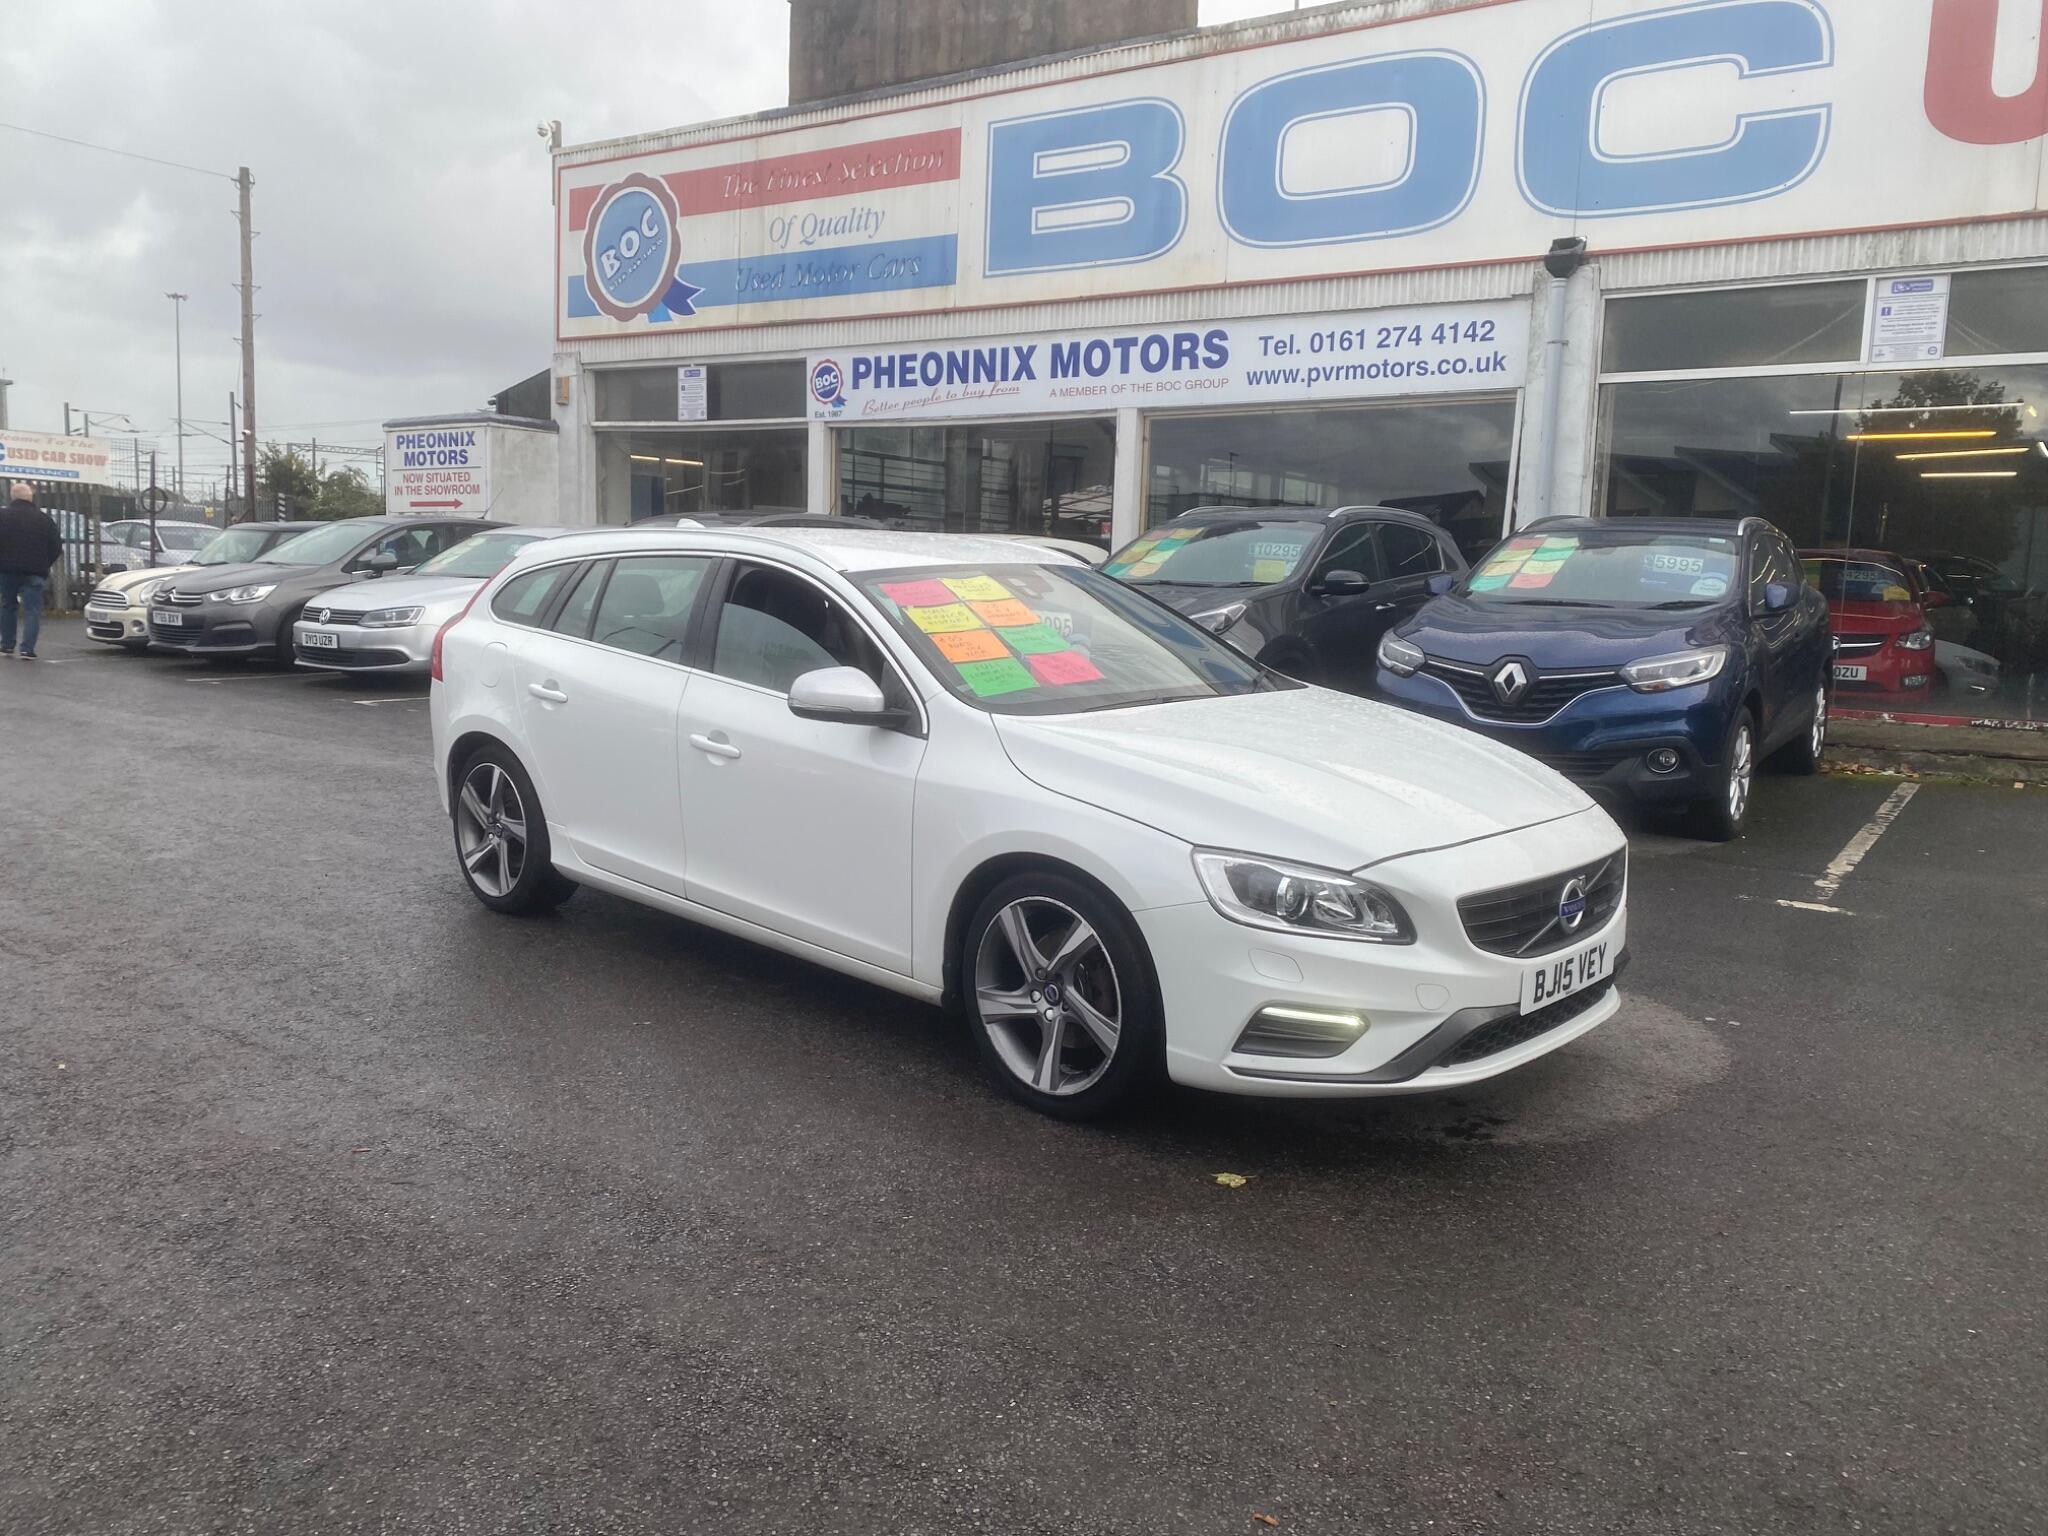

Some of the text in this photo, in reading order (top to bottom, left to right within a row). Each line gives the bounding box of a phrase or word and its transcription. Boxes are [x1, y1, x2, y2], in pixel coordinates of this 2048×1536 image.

[984, 0, 1834, 277] BOC
[722, 148, 944, 198] The Finest Selection
[769, 206, 885, 248] Of Quality
[601, 207, 659, 279] BOC
[735, 253, 924, 293] Used Motor Cars
[1258, 319, 1496, 357] Tel. 0161 274 4142
[852, 329, 1229, 390] PHEONNIX MOTORS
[1246, 351, 1507, 387] www.pvrmotors.co.uk
[816, 371, 838, 389] BOC
[1050, 378, 1229, 398] A MEMBER OF THE BOC GROUP
[862, 380, 1020, 416] Better people to buy from
[396, 431, 476, 449] PHEONNIX
[7, 447, 39, 461] USED
[41, 450, 66, 463] CAR
[69, 453, 108, 466] SHOW
[404, 449, 468, 467] MOTORS
[394, 484, 480, 496] IN THE SHOWROOM
[403, 472, 471, 483] NOW SITUATED
[1257, 543, 1299, 557] 10295
[1655, 556, 1701, 573] 5995
[319, 635, 333, 647] UZR
[1579, 942, 1608, 985] VEY
